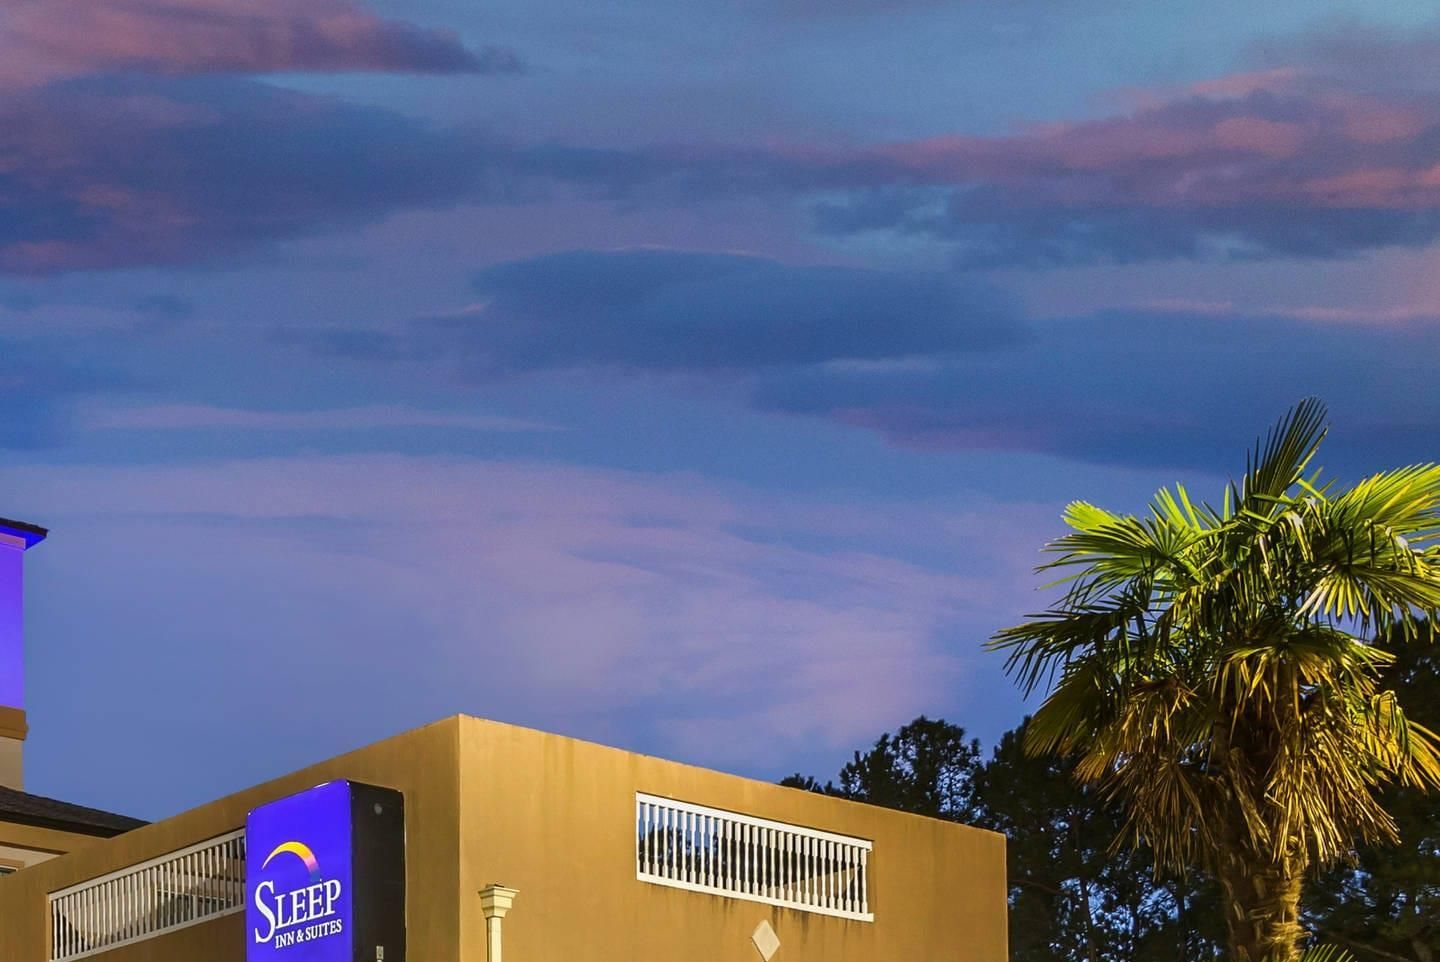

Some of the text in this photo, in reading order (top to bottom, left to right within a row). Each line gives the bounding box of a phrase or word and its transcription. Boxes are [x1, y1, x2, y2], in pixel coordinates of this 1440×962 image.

[255, 879, 341, 943] SLEEP
[275, 919, 342, 949] INN & SUITES
